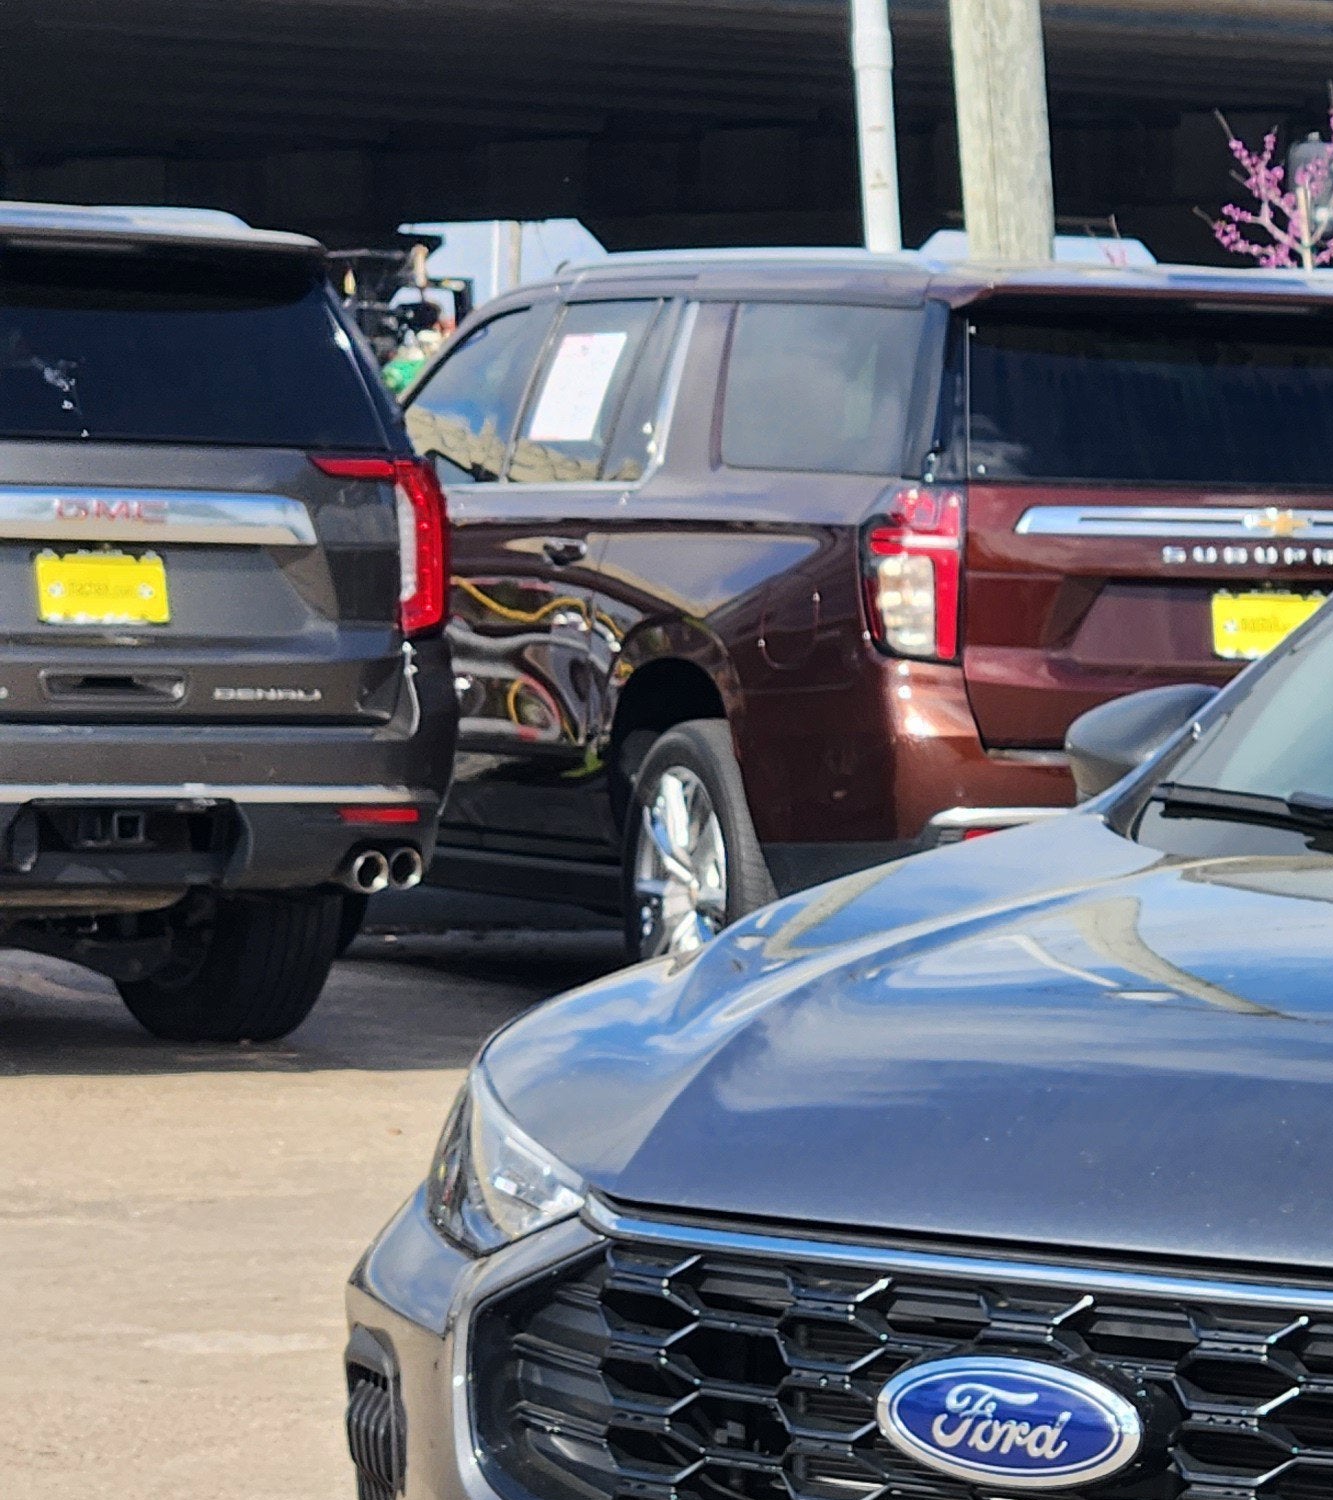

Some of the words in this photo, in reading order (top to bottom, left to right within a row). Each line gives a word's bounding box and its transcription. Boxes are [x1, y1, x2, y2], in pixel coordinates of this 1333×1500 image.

[55, 498, 169, 523] GMC
[213, 687, 322, 701] DENALI
[932, 1383, 1072, 1460] Ford
